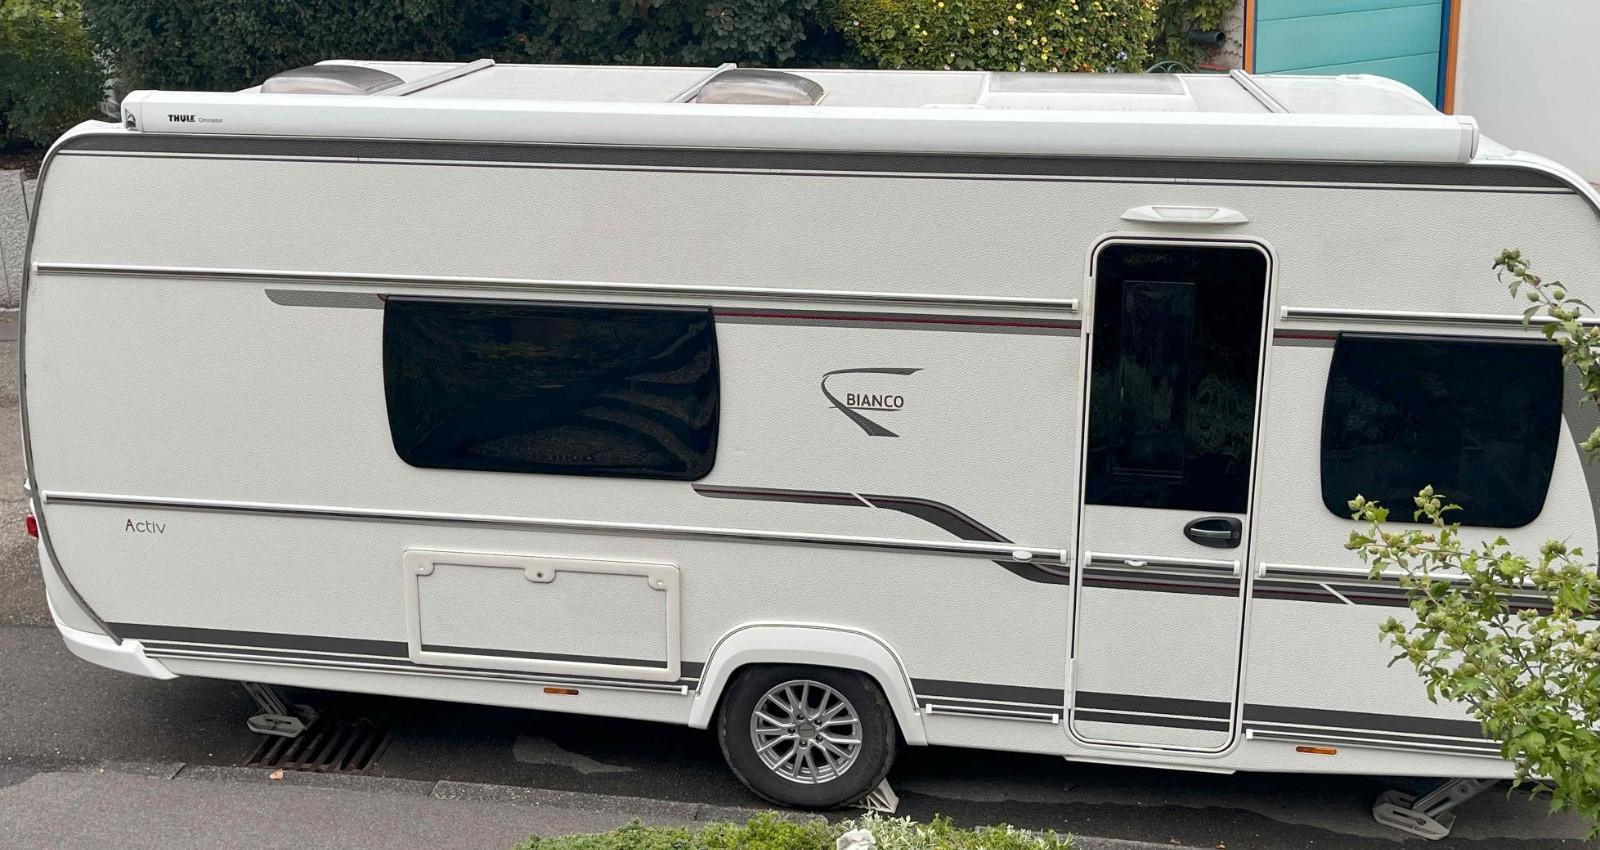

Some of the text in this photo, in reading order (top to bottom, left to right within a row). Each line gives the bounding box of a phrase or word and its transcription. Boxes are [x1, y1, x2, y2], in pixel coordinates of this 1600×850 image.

[168, 114, 195, 122] THULE
[846, 393, 904, 408] BIANCO
[125, 518, 166, 533] Activ
